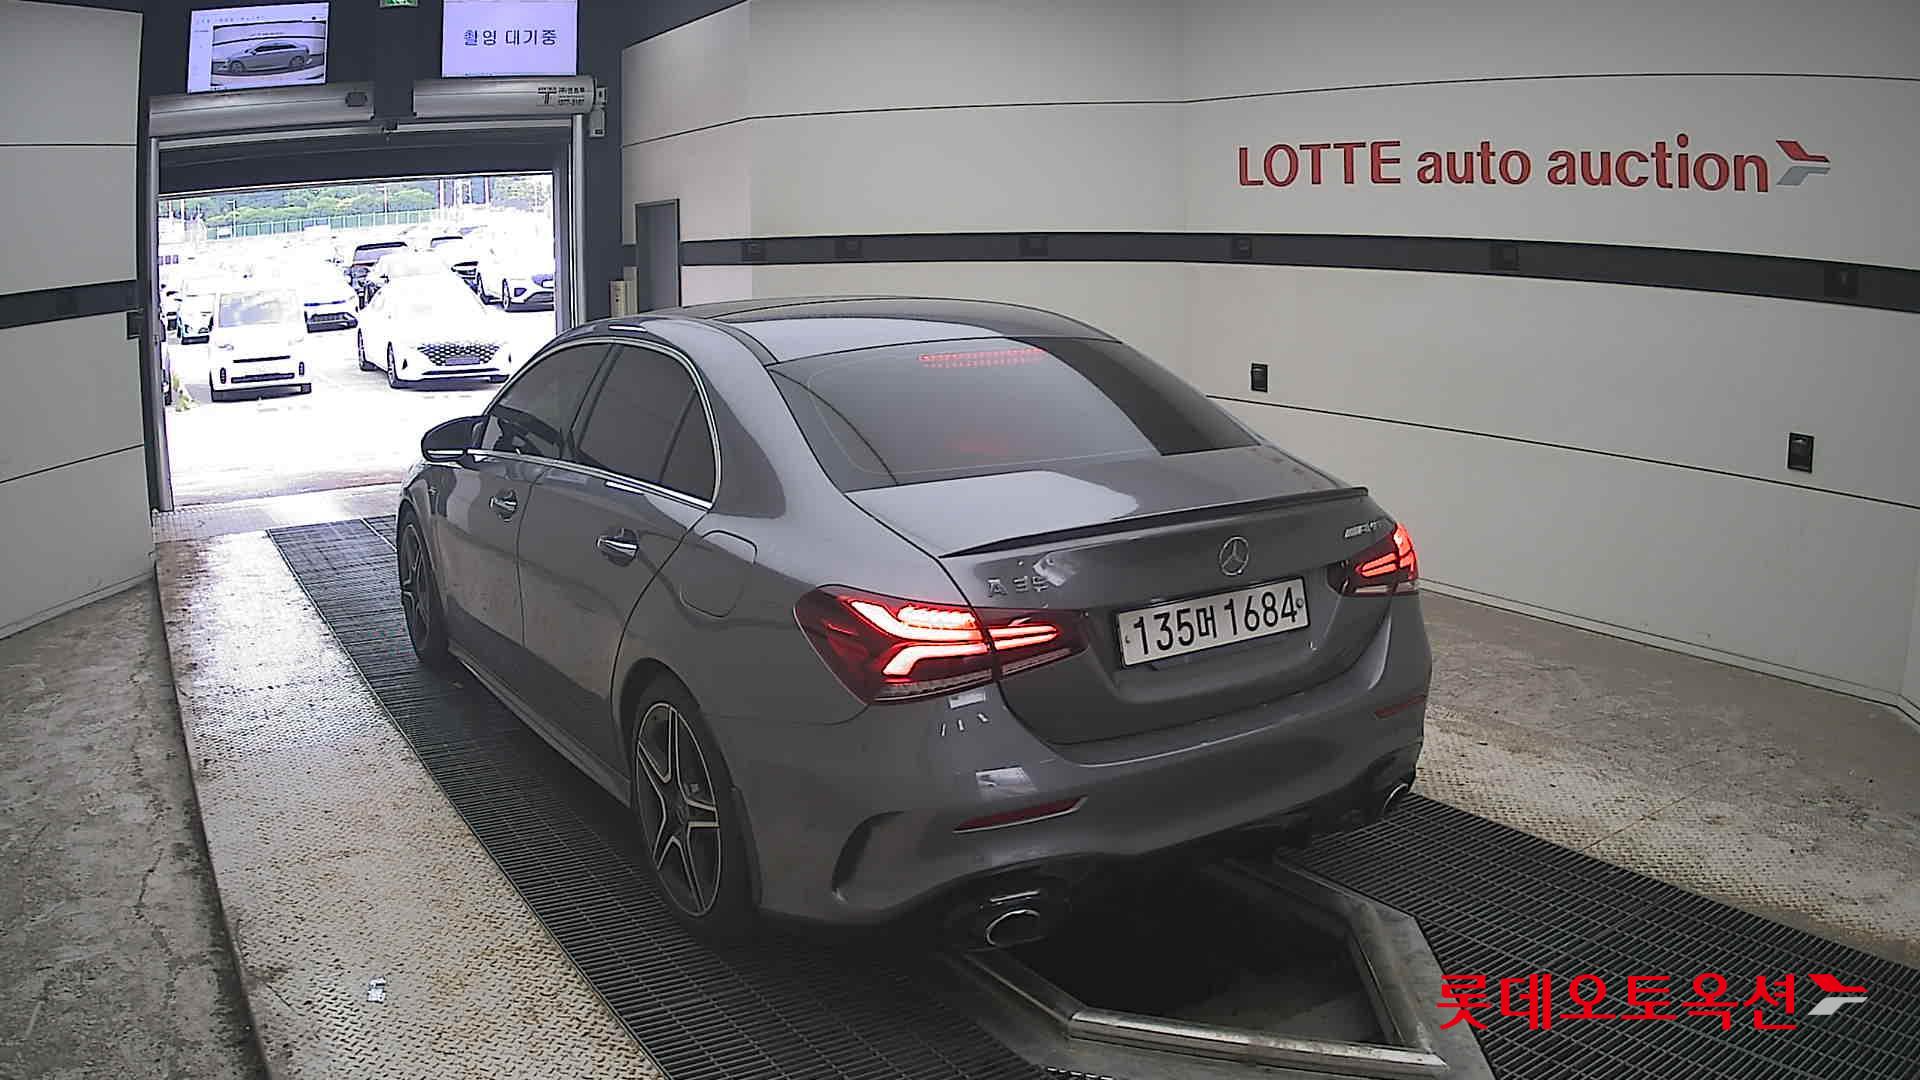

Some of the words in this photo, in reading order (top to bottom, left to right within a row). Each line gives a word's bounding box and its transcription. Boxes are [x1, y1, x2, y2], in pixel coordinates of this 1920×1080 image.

[505, 29, 558, 46] 대기중
[1238, 141, 1400, 186] LOTTE
[1416, 141, 1532, 185] auto
[1547, 134, 1769, 193] auction
[1133, 604, 1218, 656] 135머
[1223, 586, 1298, 636] 1684
